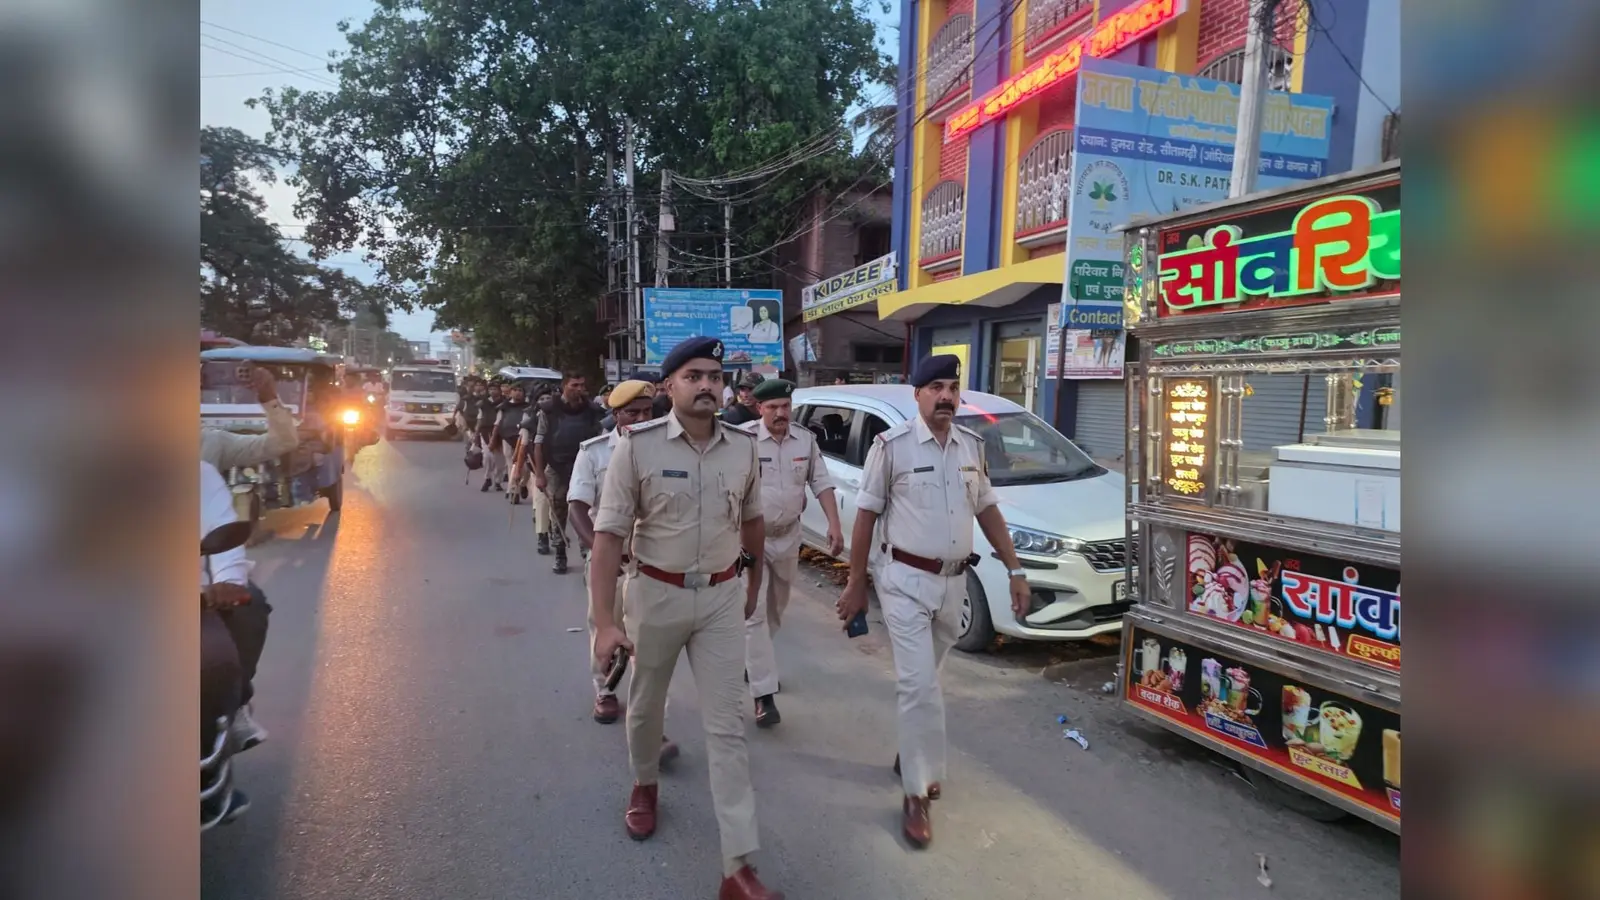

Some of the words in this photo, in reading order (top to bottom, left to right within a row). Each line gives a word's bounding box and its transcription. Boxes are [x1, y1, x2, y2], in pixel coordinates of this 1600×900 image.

[1273, 156, 1285, 170] के
[1157, 170, 1176, 184] DR.
[1180, 172, 1201, 187] S.K.
[1204, 175, 1231, 191] PATH
[1074, 262, 1109, 277] परिवार
[1112, 263, 1124, 278] नि
[812, 262, 882, 302] KIDZEE
[1085, 281, 1100, 296] एवं
[1069, 308, 1122, 325] Contact
[1281, 566, 1400, 640] सांव
